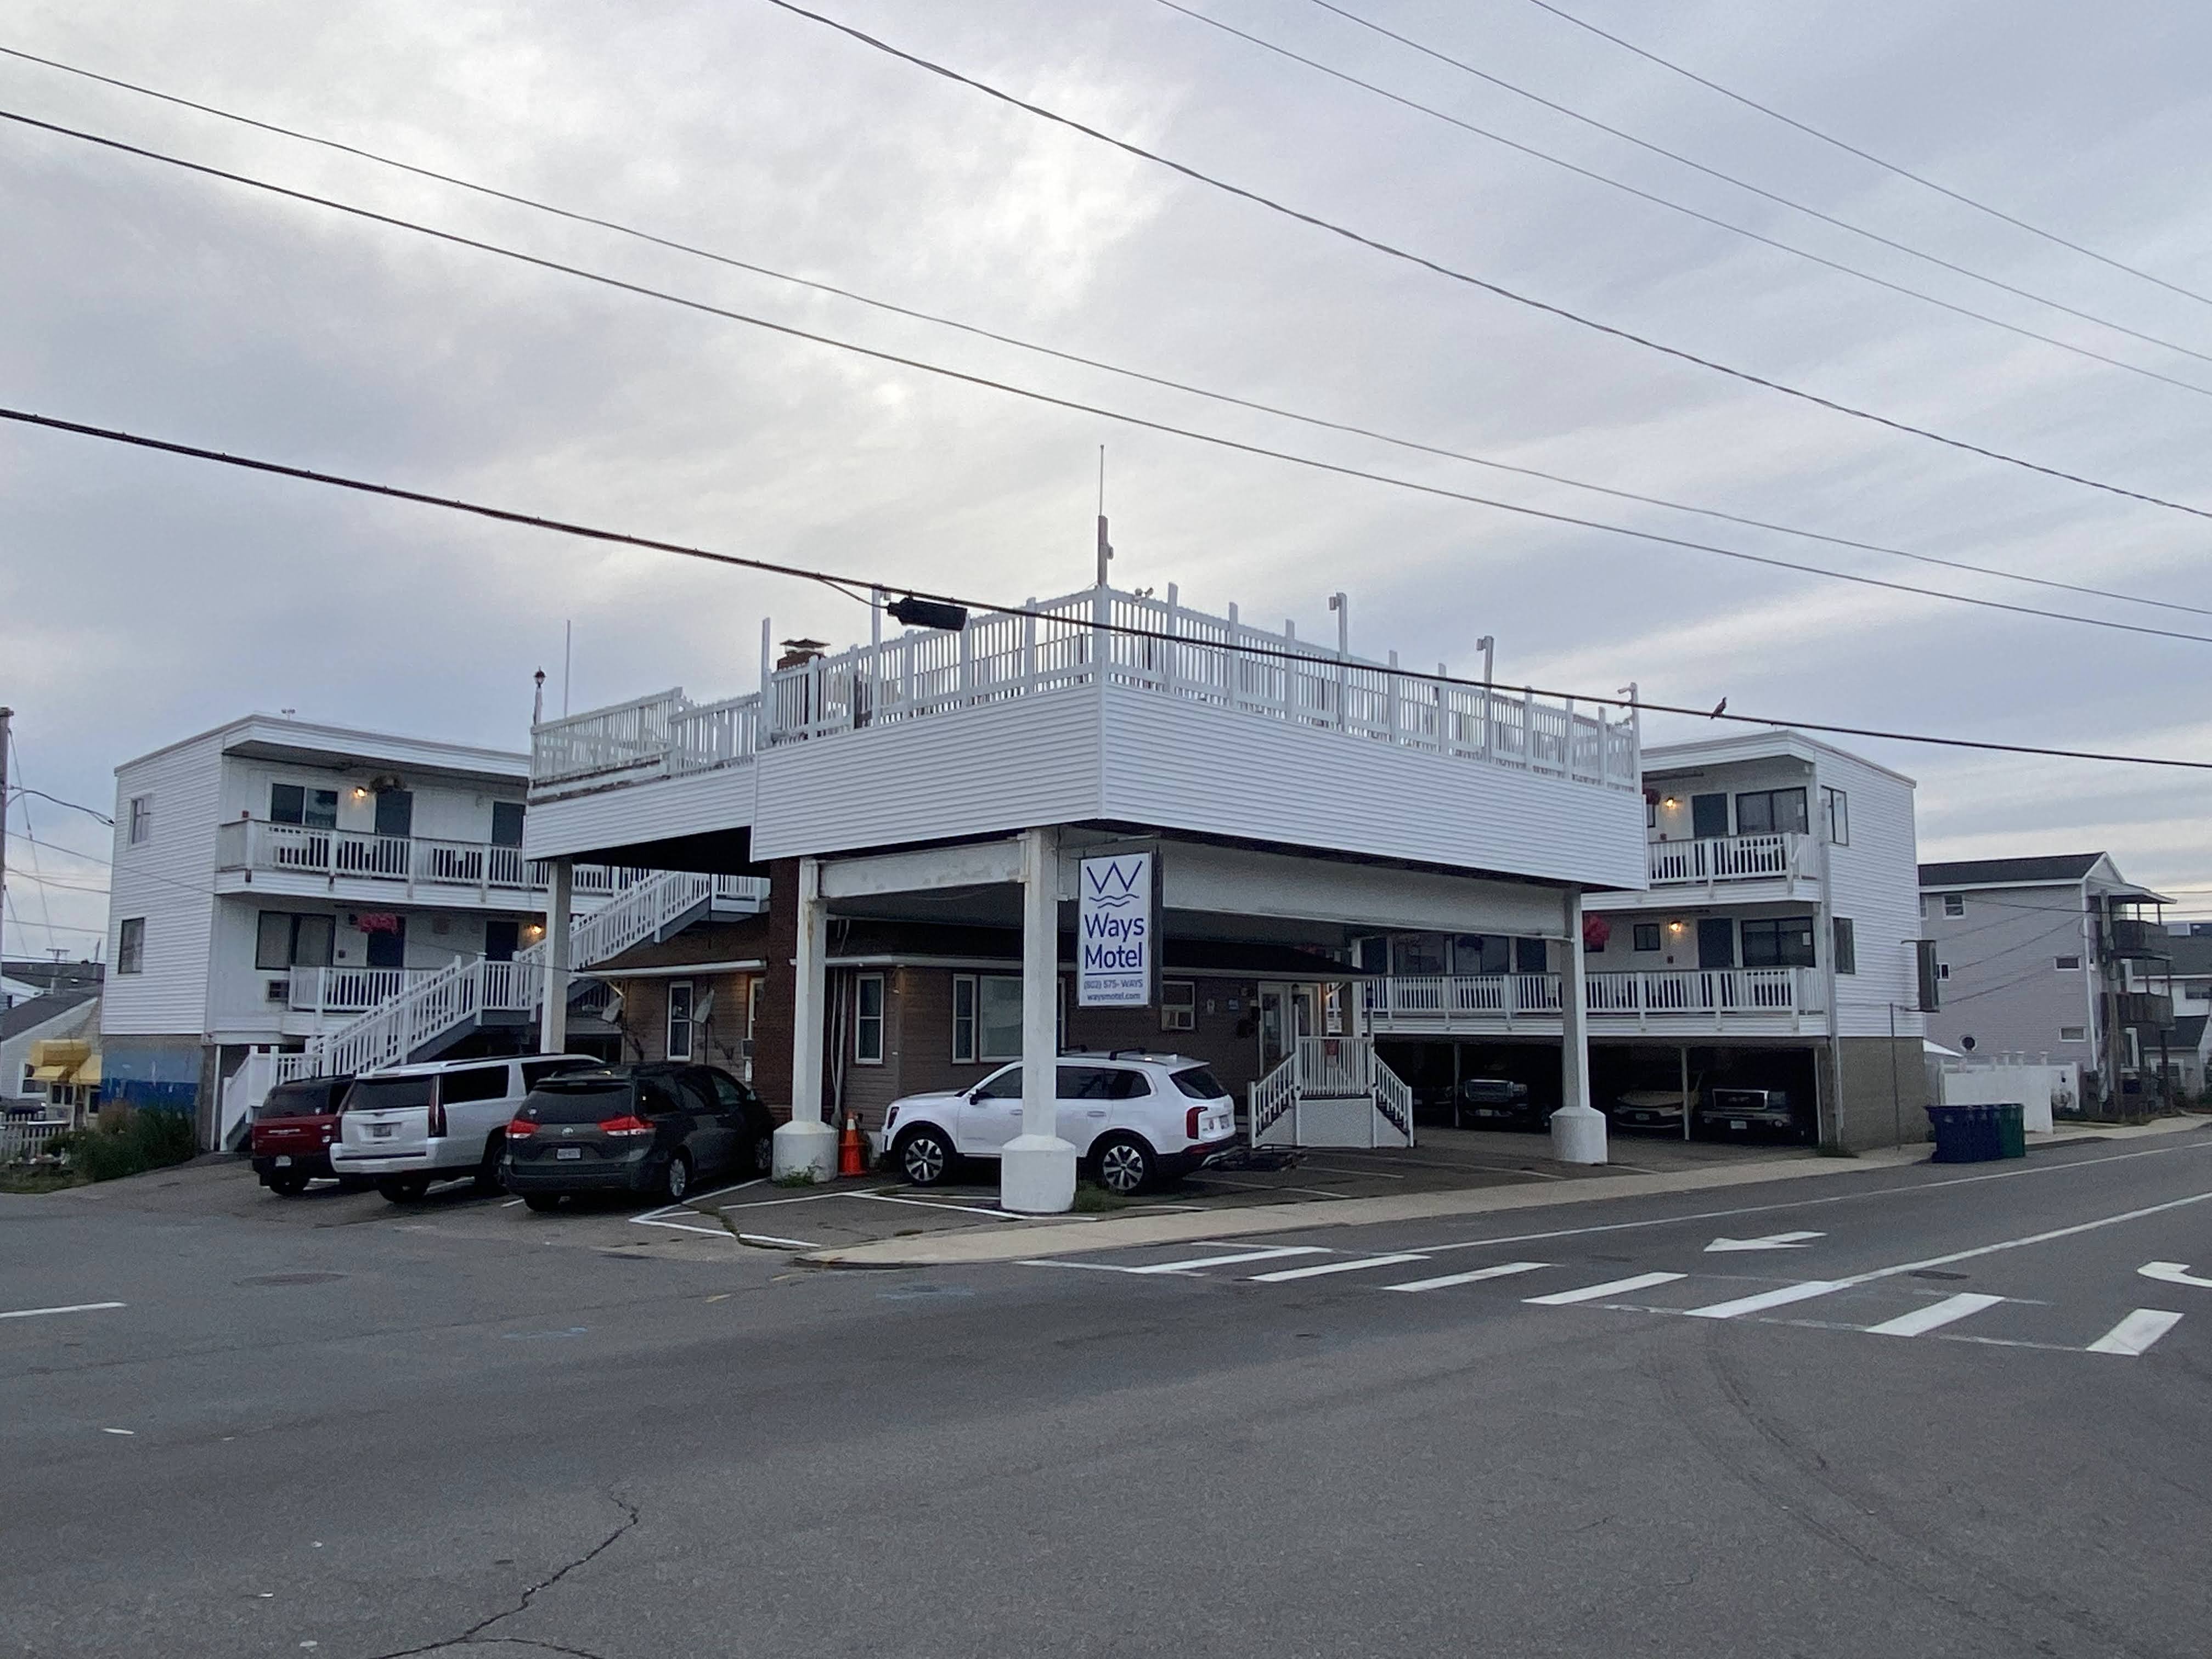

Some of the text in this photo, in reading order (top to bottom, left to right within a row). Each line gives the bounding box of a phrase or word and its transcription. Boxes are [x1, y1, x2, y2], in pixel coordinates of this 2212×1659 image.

[1084, 912, 1144, 943] Ways
[1084, 942, 1143, 969] Motel
[1087, 992, 1141, 1001] waysmotel.com
